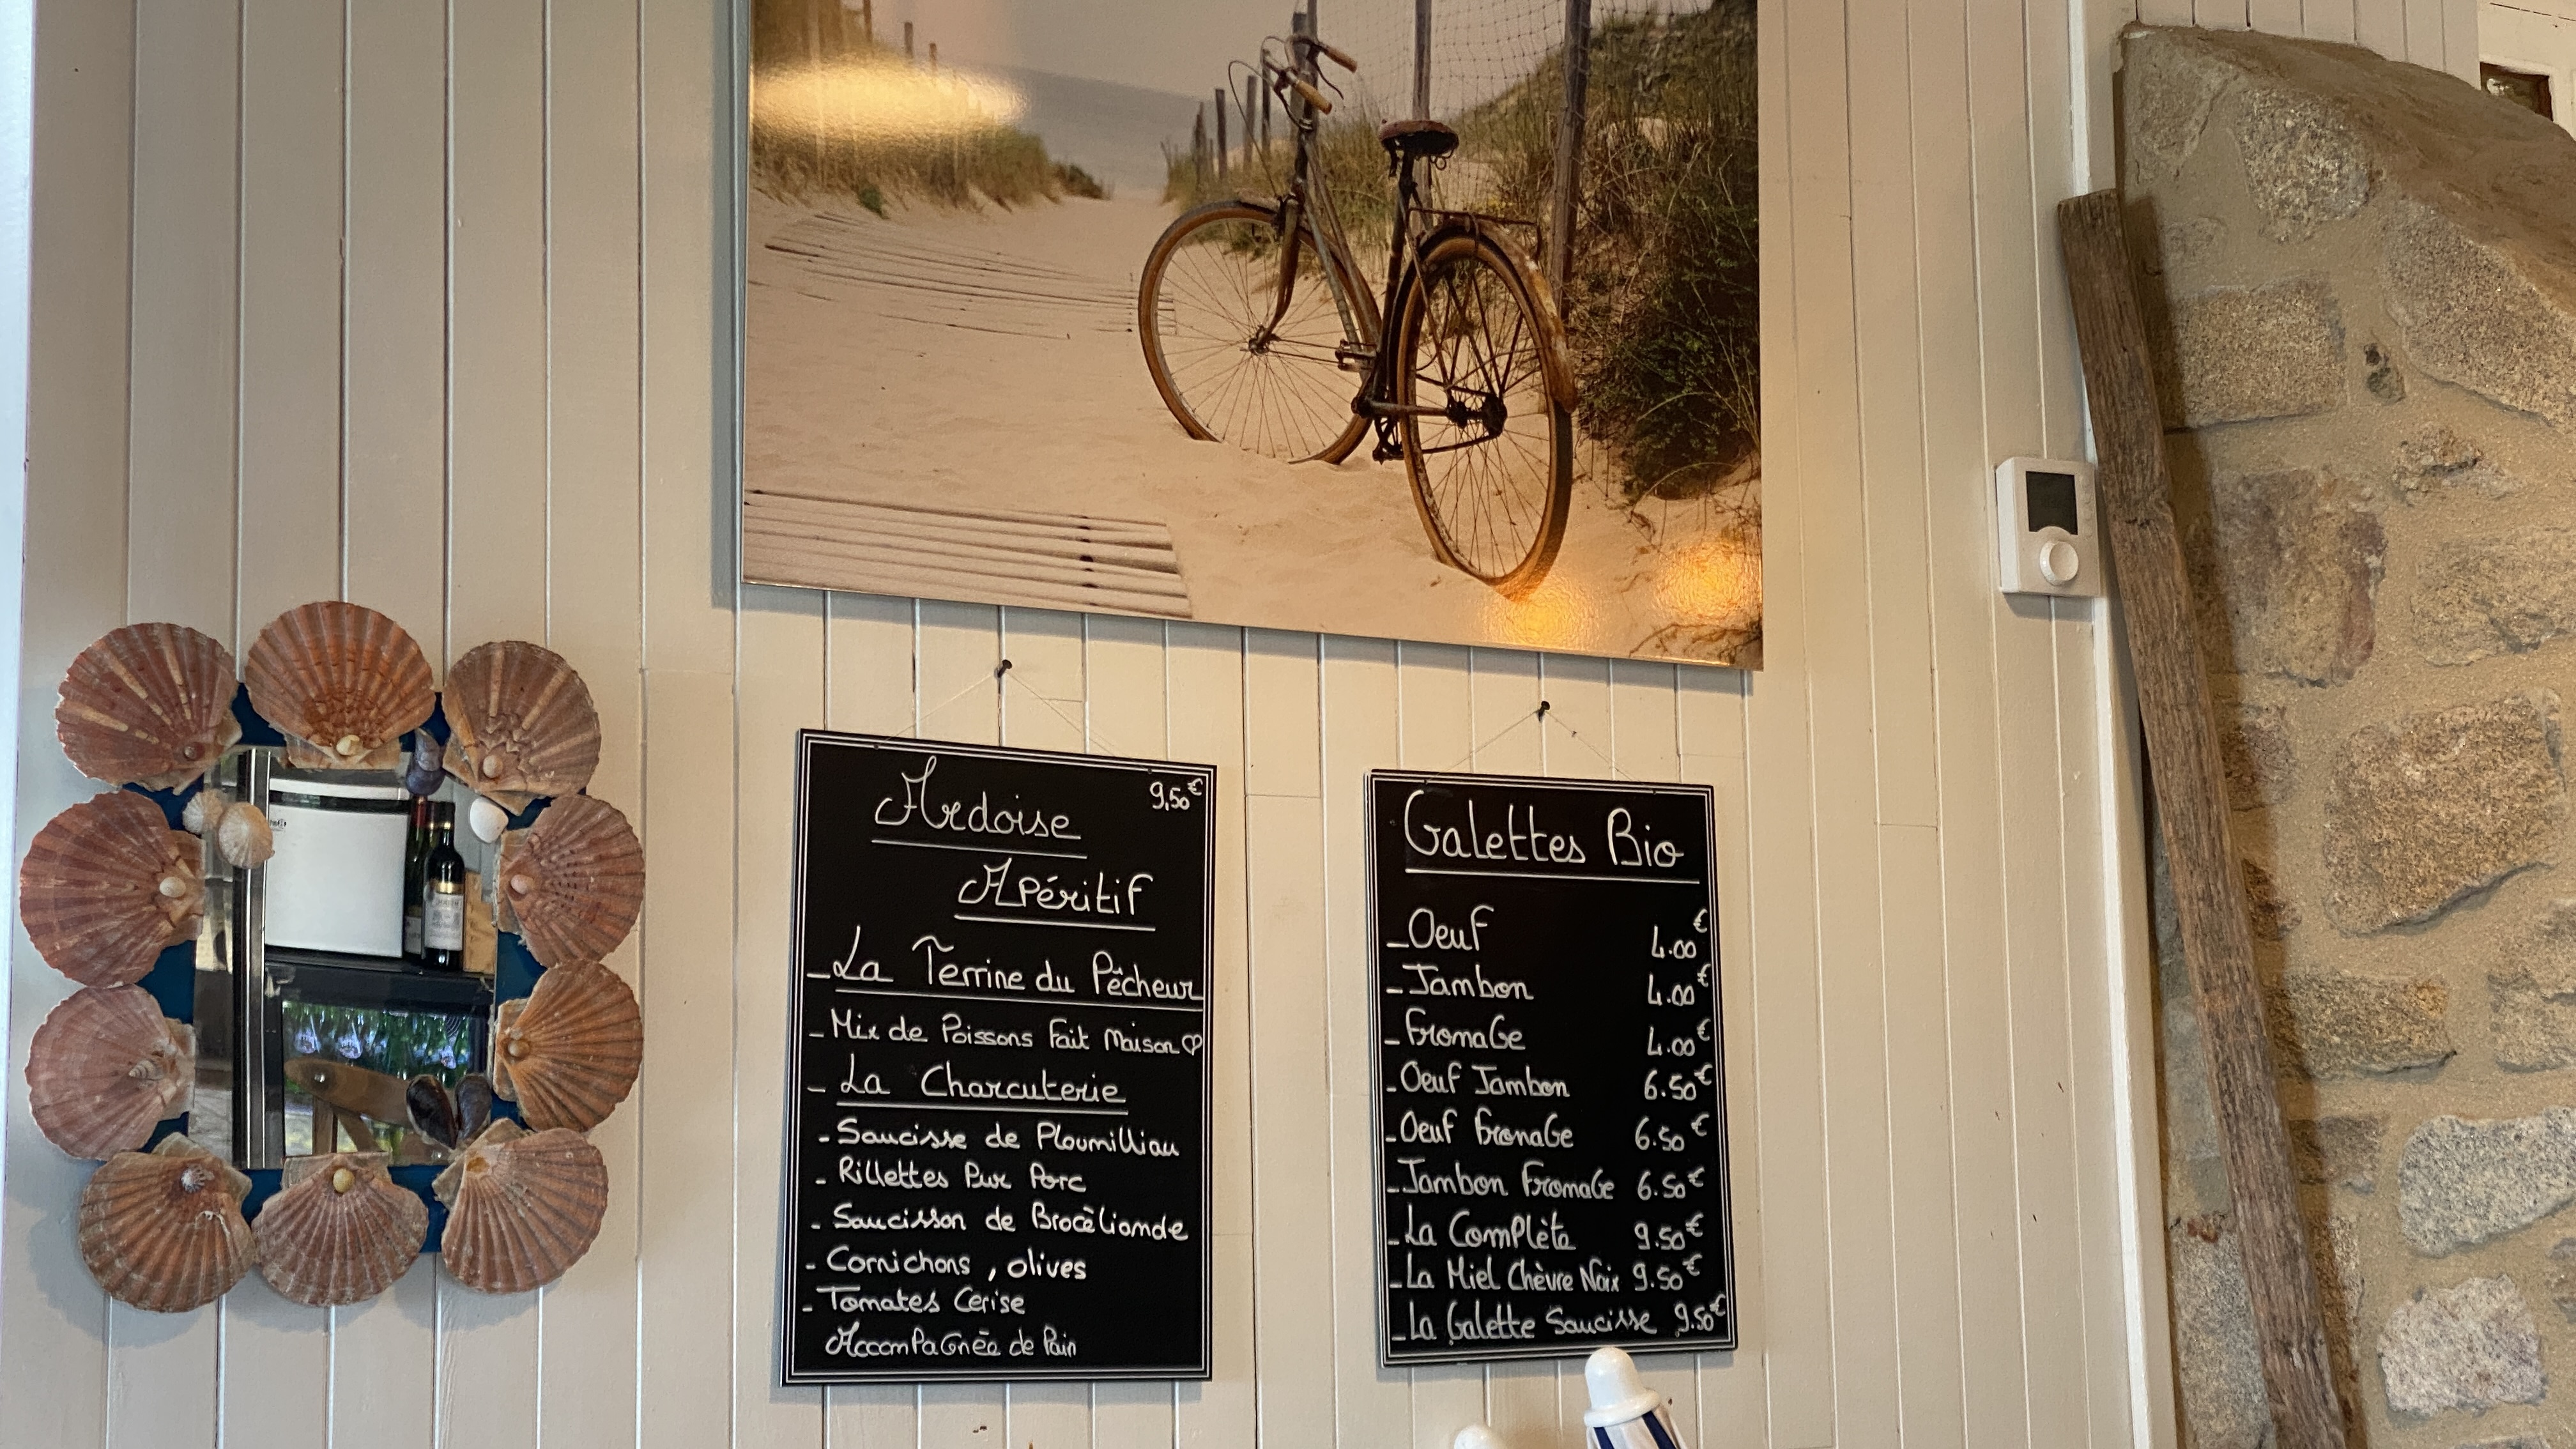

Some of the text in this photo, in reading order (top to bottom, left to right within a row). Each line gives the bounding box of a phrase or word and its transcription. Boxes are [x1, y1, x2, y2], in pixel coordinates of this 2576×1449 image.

[875, 755, 1082, 839] Ardoise
[1405, 790, 1683, 867] Galettes Bio
[833, 926, 1204, 1000] La Terrine du Pêcheur
[1402, 964, 1533, 999] Jambon
[831, 1009, 879, 1039] Mix
[889, 1016, 928, 1042] de
[942, 1014, 1032, 1046] Poissons
[1050, 1018, 1089, 1049] Fait
[841, 1054, 1126, 1103] La Charcuterie
[1472, 1066, 1570, 1097] Jambon
[838, 1117, 1179, 1156] Saucisse de Ploumilliau
[839, 1156, 1086, 1192] Rillettes Pur Porc
[1398, 1159, 1508, 1195] Jambon
[834, 1203, 966, 1230] Saucisson
[986, 1206, 1015, 1232] de
[1405, 1204, 1437, 1246] La
[827, 1246, 970, 1275] Cornichons
[1008, 1248, 1086, 1279] olives
[1407, 1253, 1434, 1288] La
[1448, 1256, 1500, 1289] Miel
[1508, 1259, 1573, 1291] Chèvre
[816, 1286, 1025, 1314] Tomates Cerise
[1410, 1301, 1437, 1340] La
[1448, 1301, 1535, 1339] Galette
[1546, 1308, 1657, 1334] Saucisse
[1009, 1330, 1034, 1356] de
[1044, 1326, 1076, 1357] Pain
